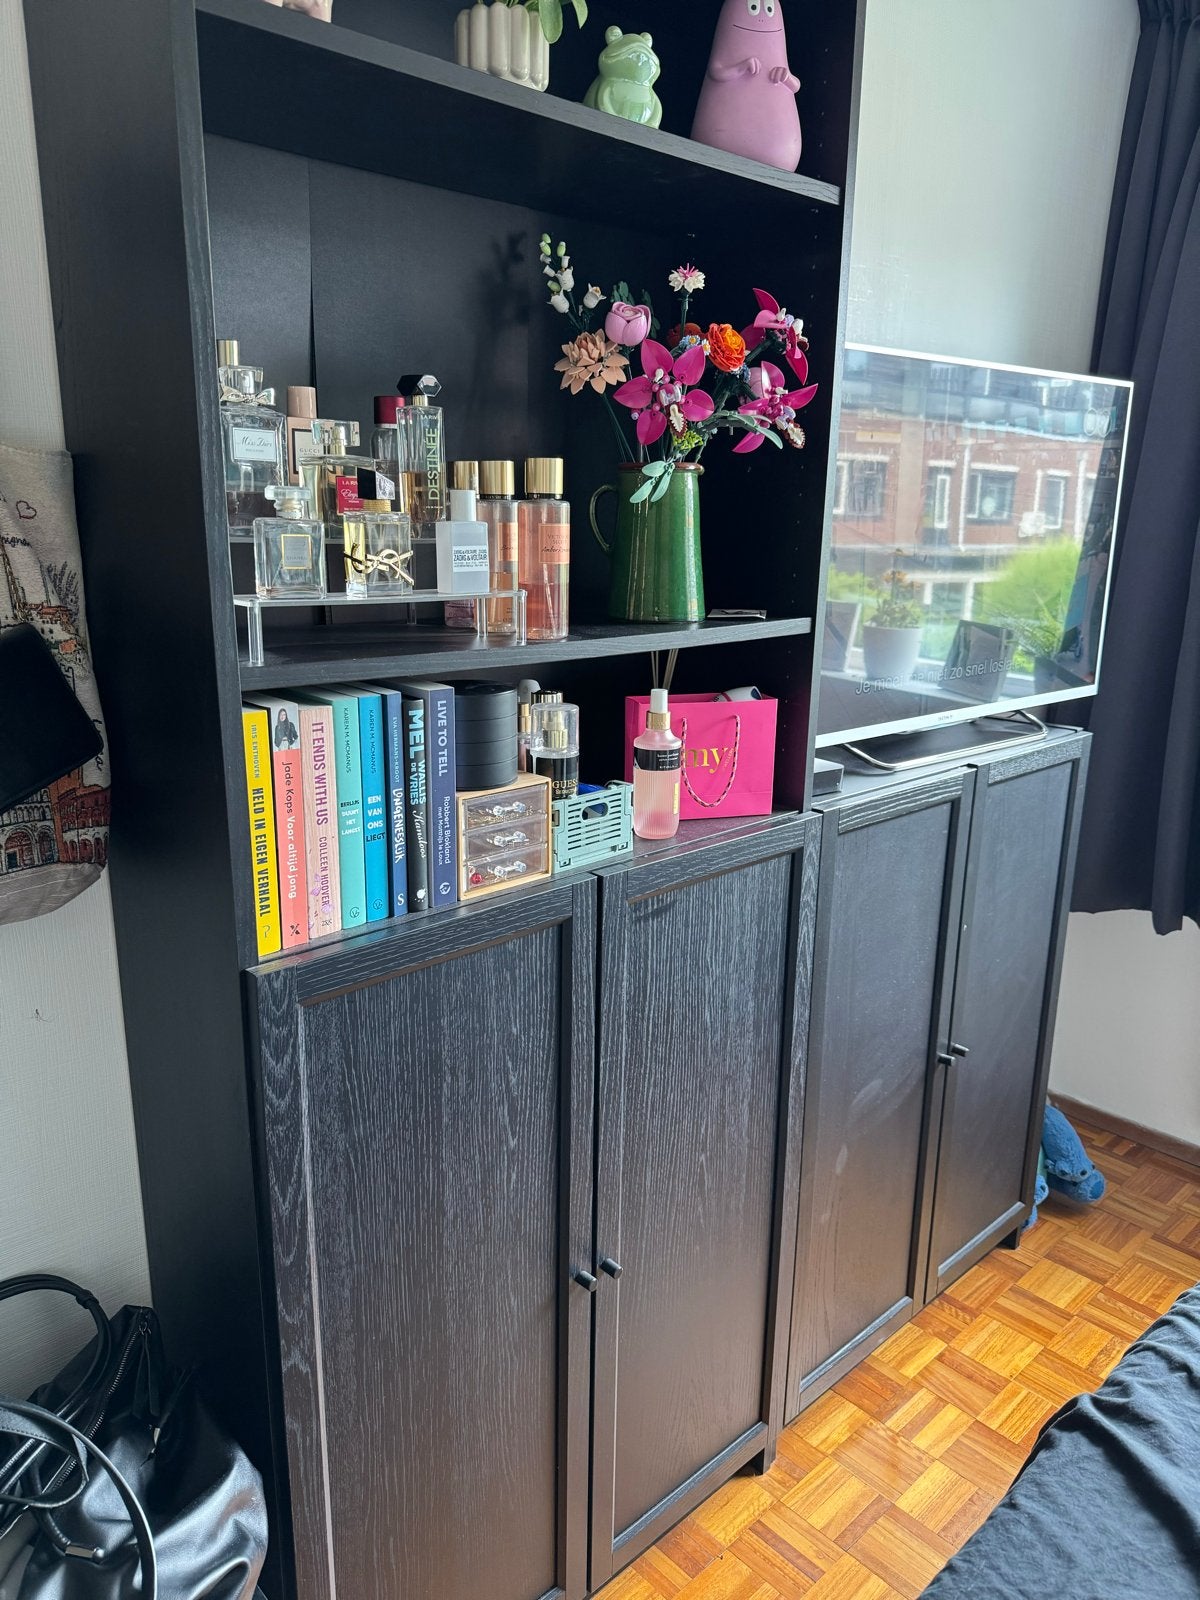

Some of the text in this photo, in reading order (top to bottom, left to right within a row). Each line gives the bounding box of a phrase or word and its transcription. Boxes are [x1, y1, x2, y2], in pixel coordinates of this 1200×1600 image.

[241, 436, 273, 447] Miss Dior
[425, 427, 440, 500] DESTINÉE
[471, 553, 488, 561] VOLTAIR
[855, 678, 871, 695] Je
[927, 668, 948, 683] niet
[949, 666, 963, 681] zo
[965, 661, 988, 677] snel
[408, 709, 425, 759] MEL
[437, 700, 448, 777] LIVE TO TELL
[252, 741, 260, 779] ENTHOVEN
[311, 722, 329, 826] IT ENDS WITH US
[344, 740, 352, 774] MCMANUS
[369, 741, 377, 774] MCMANUS
[392, 730, 400, 784] HERMANS-KROOT
[685, 747, 729, 774] my
[282, 762, 296, 814] Jade Kops
[367, 795, 381, 804] EEN
[409, 762, 419, 806] DE VRIES
[417, 760, 427, 804] WALLIS
[552, 779, 579, 788] GUES
[341, 808, 360, 818] DUURT
[345, 818, 356, 826] HET
[367, 808, 382, 817] VAN
[367, 820, 384, 829] ONS
[443, 795, 452, 864] Robbert Blokland
[341, 827, 361, 836] LANGST
[366, 832, 386, 843] LIEGT
[412, 809, 428, 859] Kansloos
[252, 787, 271, 918] HELD IN EIGEN VERHAAL
[286, 816, 298, 899] Voor altijd jong
[318, 836, 330, 907] COLLEEN HOOVER
